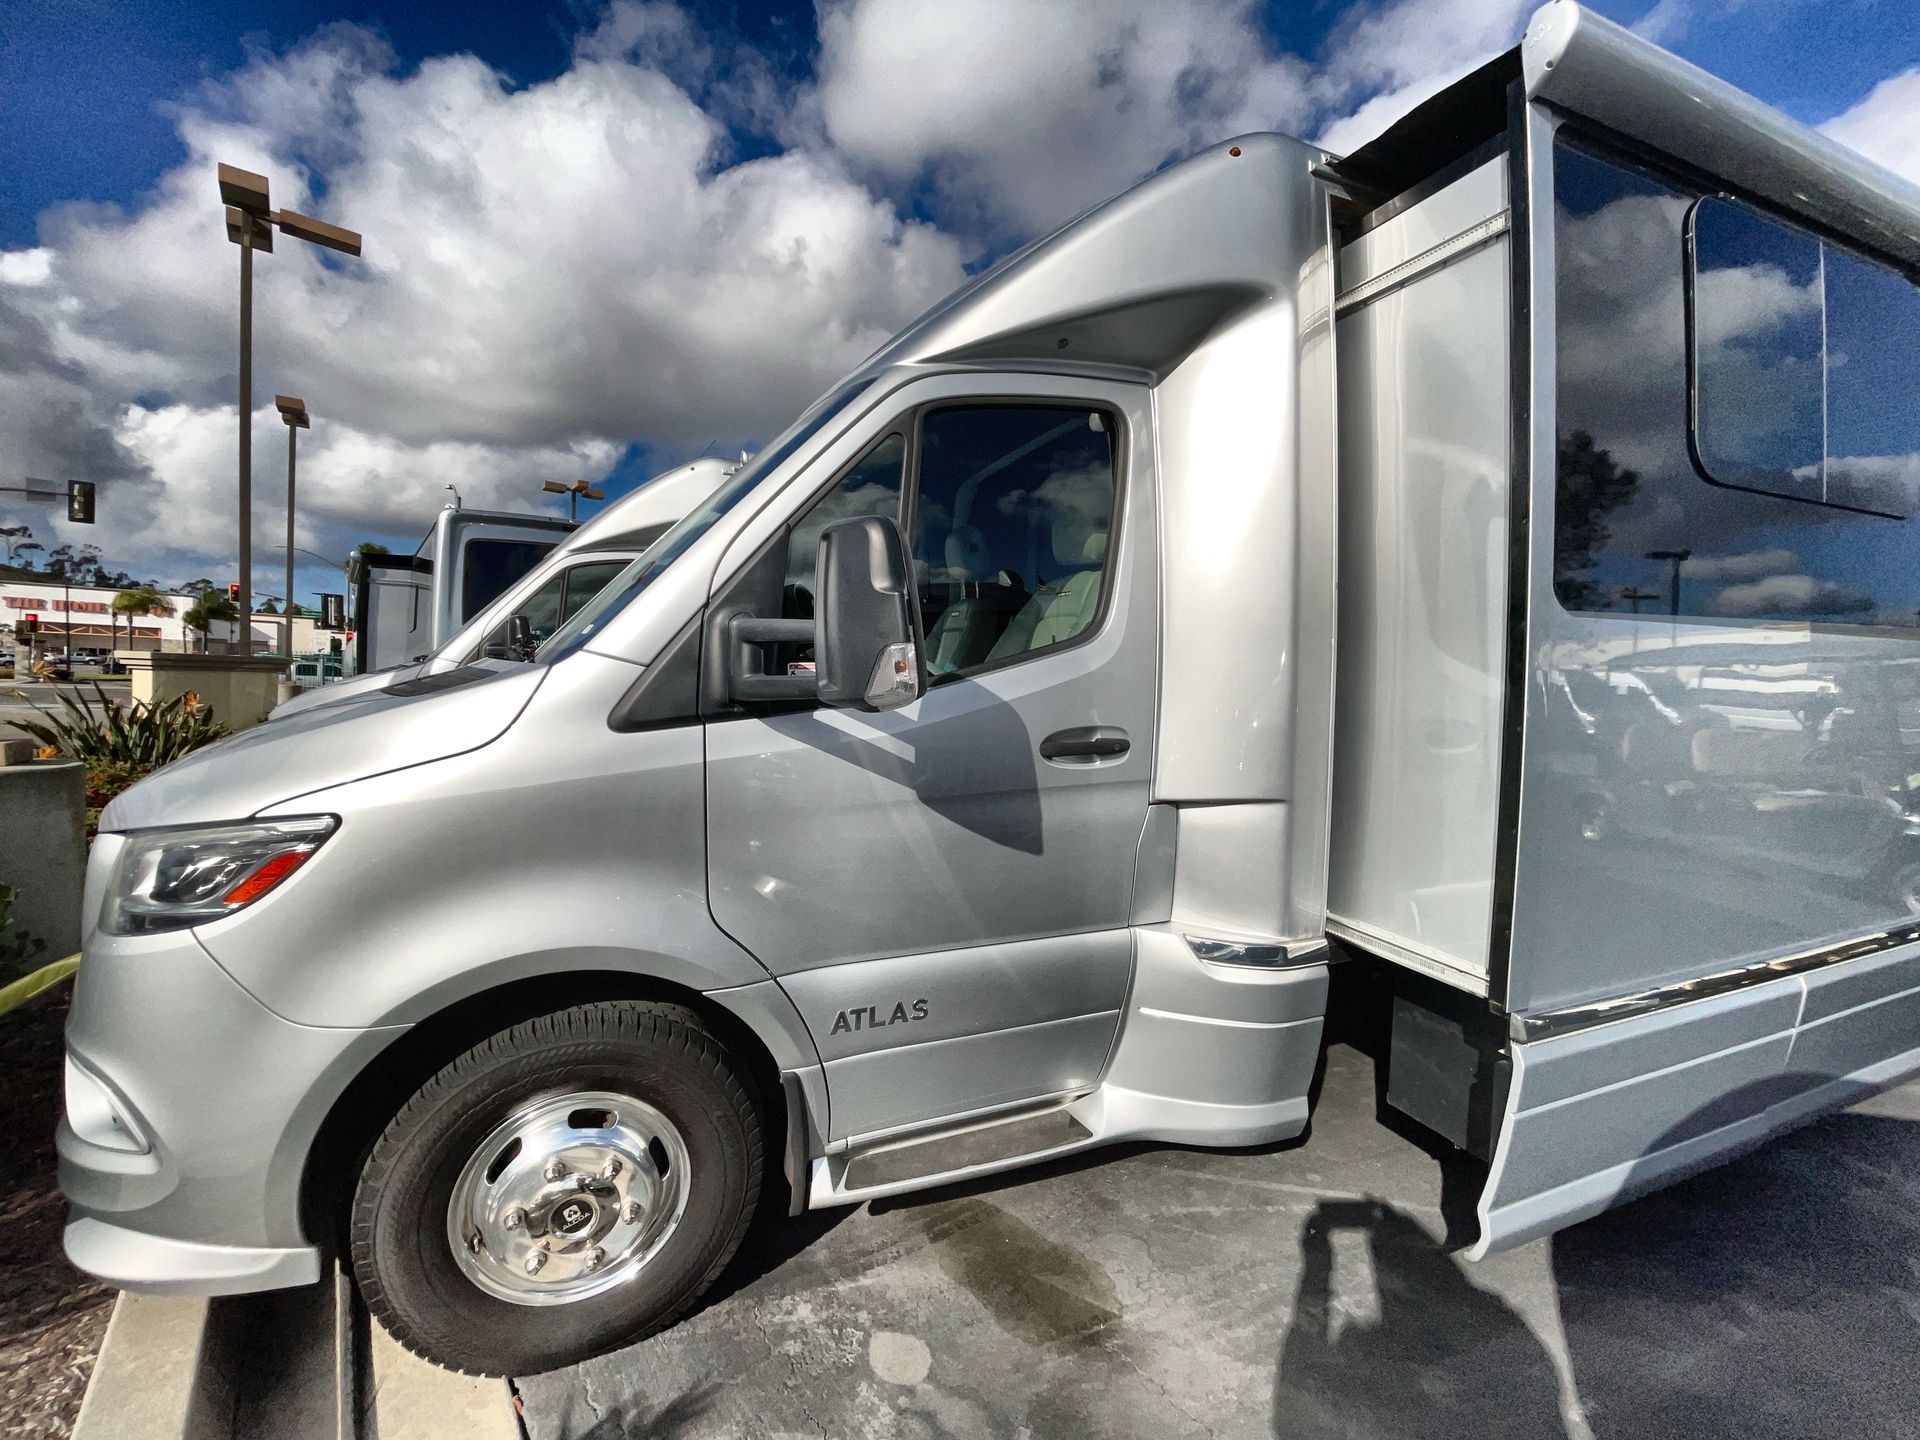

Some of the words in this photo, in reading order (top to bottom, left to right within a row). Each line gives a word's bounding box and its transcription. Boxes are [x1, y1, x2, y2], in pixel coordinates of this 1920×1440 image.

[2, 596, 48, 610] THE
[51, 599, 109, 614] HOME
[829, 998, 929, 1035] ATLAS
[562, 1212, 591, 1231] ALCOA
